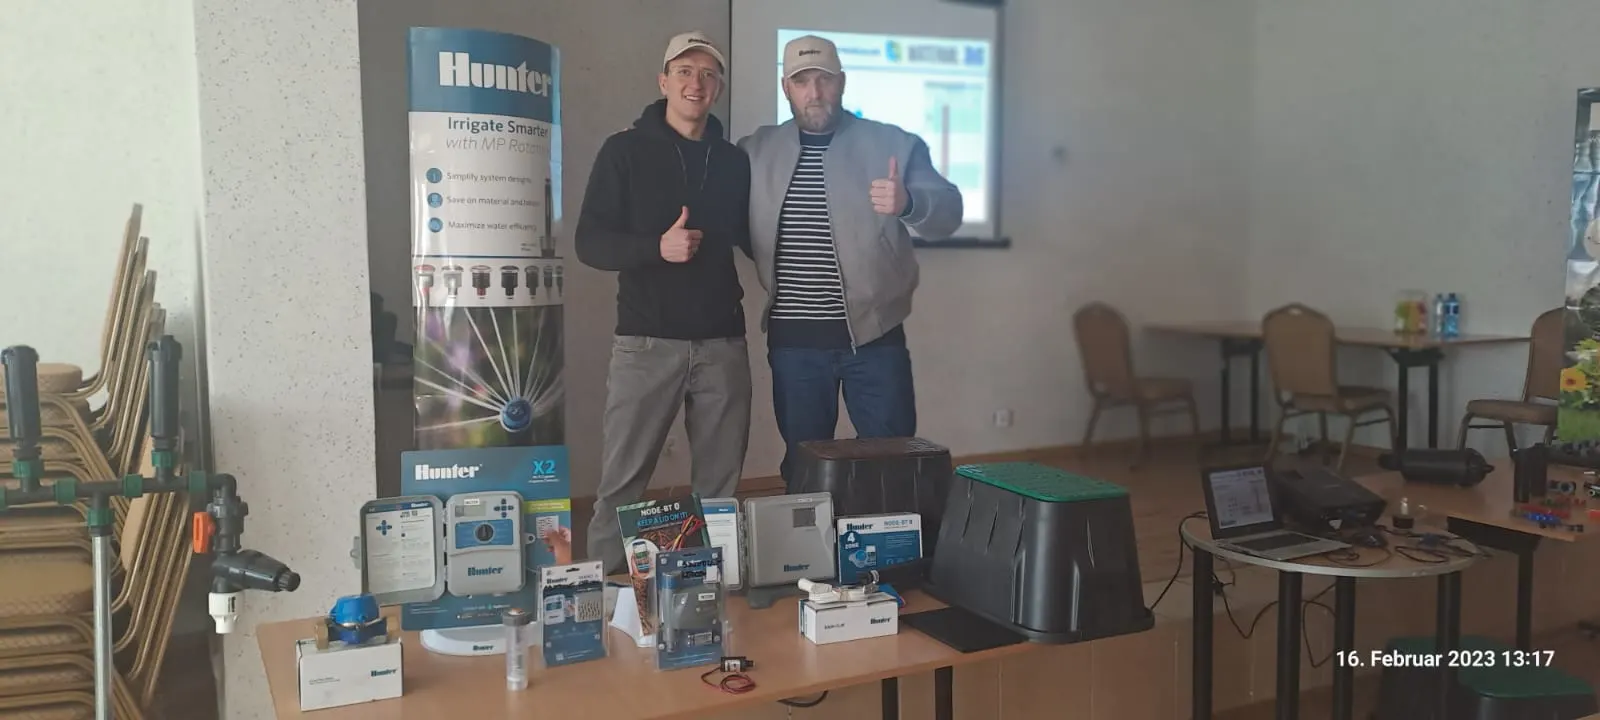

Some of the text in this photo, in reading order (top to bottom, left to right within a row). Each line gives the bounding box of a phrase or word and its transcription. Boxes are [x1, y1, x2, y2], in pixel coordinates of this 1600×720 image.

[438, 51, 551, 97] Hunter
[448, 117, 548, 138] Irrigate Smarter
[446, 136, 477, 150] with
[481, 137, 506, 151] MP
[447, 172, 479, 182] Simplify
[480, 174, 507, 184] system
[447, 196, 465, 204] Save
[478, 197, 509, 205] material
[448, 221, 485, 229] Maximize
[487, 222, 507, 230] water
[415, 463, 479, 480] Hunter
[533, 460, 555, 474] X2
[848, 533, 855, 542] 4
[467, 566, 503, 577] Hunter
